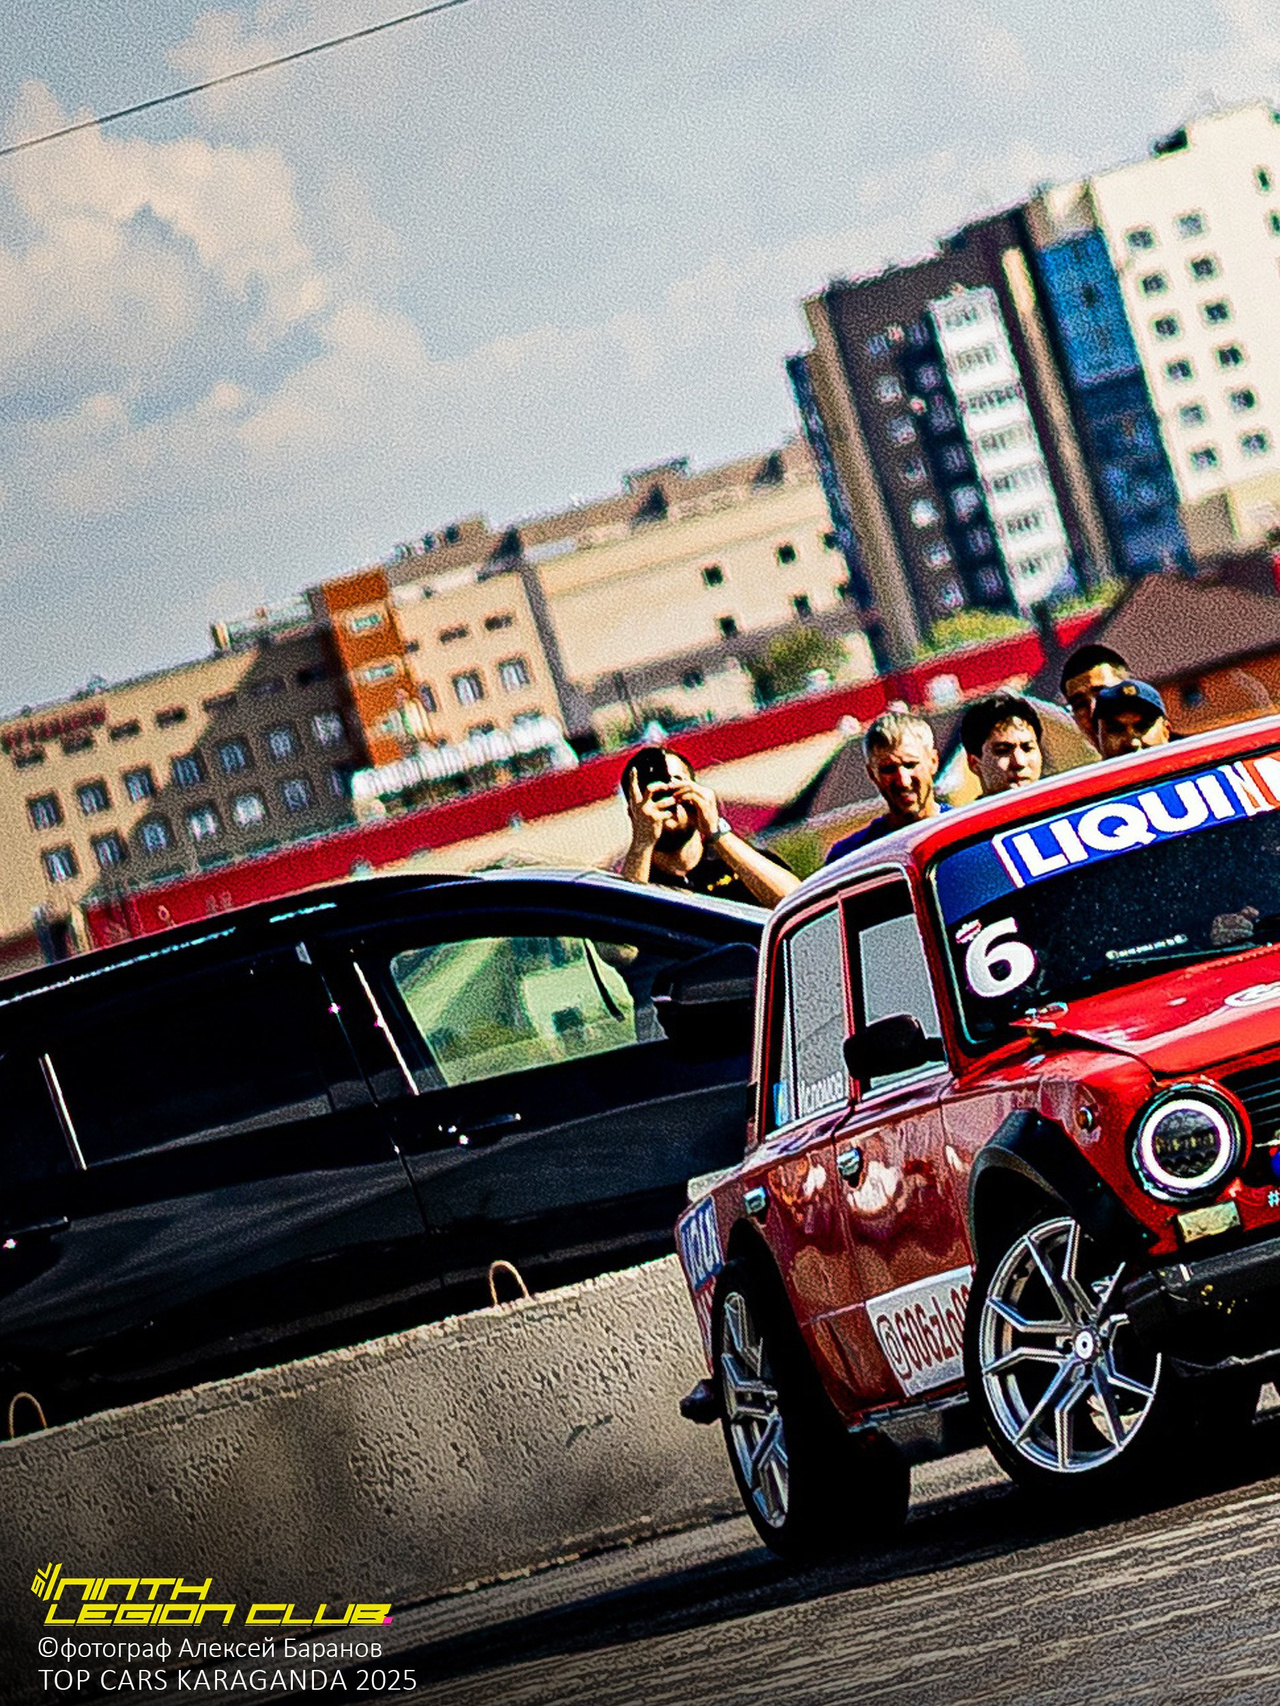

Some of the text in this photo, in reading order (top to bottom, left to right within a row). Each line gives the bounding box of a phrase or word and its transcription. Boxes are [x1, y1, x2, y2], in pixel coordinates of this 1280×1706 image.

[1012, 770, 1235, 878] LIQUI
[965, 916, 1036, 998] 6
[876, 1283, 969, 1380] @606zlo0
